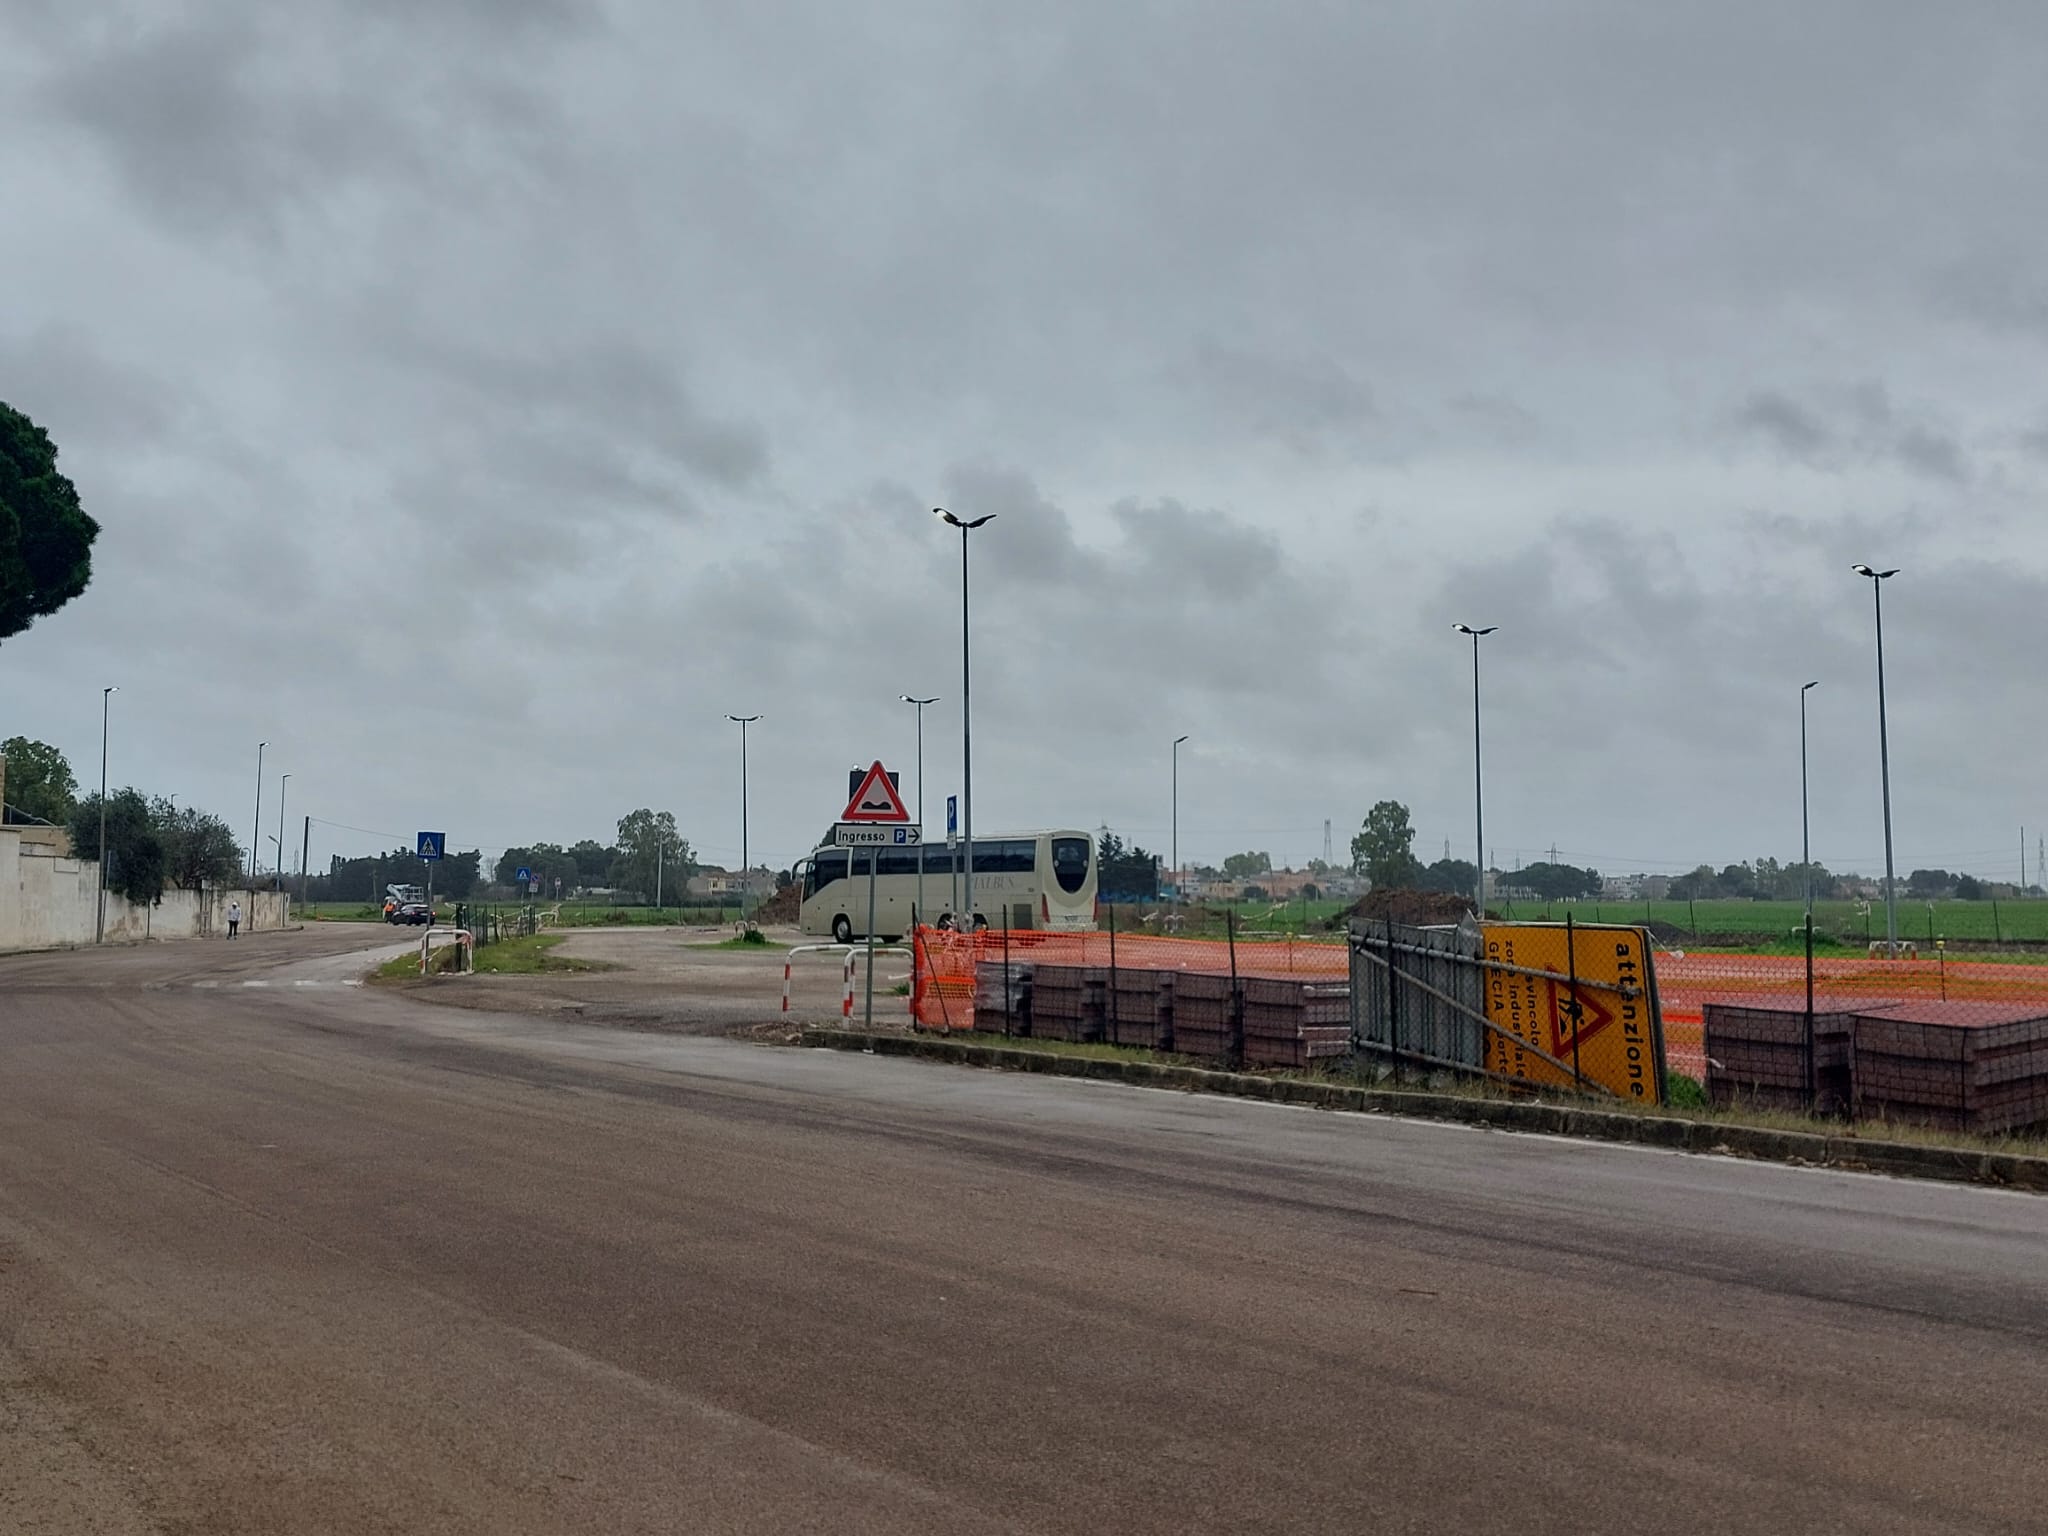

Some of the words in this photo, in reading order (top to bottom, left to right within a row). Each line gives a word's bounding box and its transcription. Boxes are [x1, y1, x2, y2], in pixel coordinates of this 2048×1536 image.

[838, 830, 885, 843] Ingresso
[896, 830, 905, 842] P
[948, 799, 955, 828] P
[1509, 985, 1526, 1077] industiale
[1525, 974, 1541, 1046] svincolo
[1615, 943, 1644, 1097] attenzione
